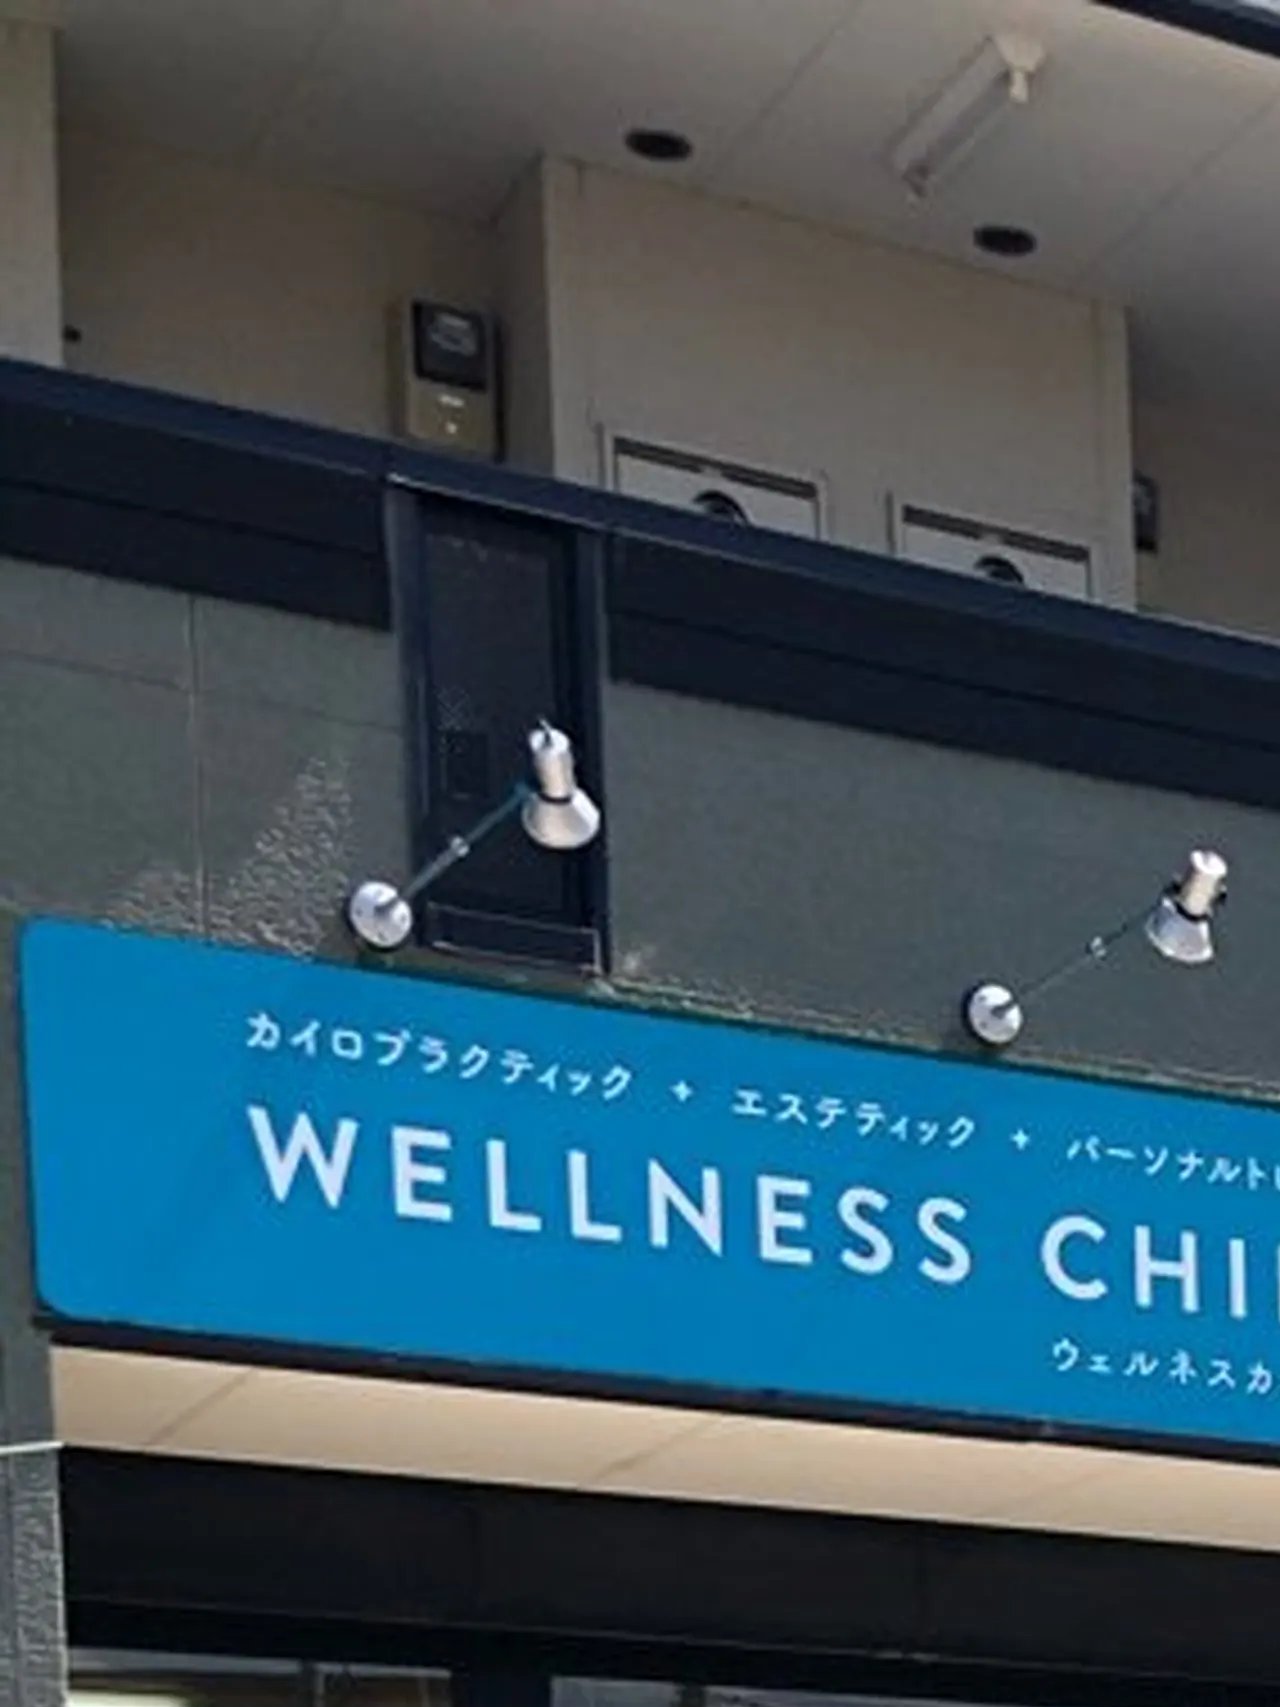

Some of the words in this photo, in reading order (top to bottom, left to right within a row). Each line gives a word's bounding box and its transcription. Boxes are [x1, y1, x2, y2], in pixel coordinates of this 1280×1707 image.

[245, 1011, 633, 1101] カイロプラクティック
[735, 1088, 976, 1150] エステティック
[247, 1105, 972, 1285] WELLNESS
